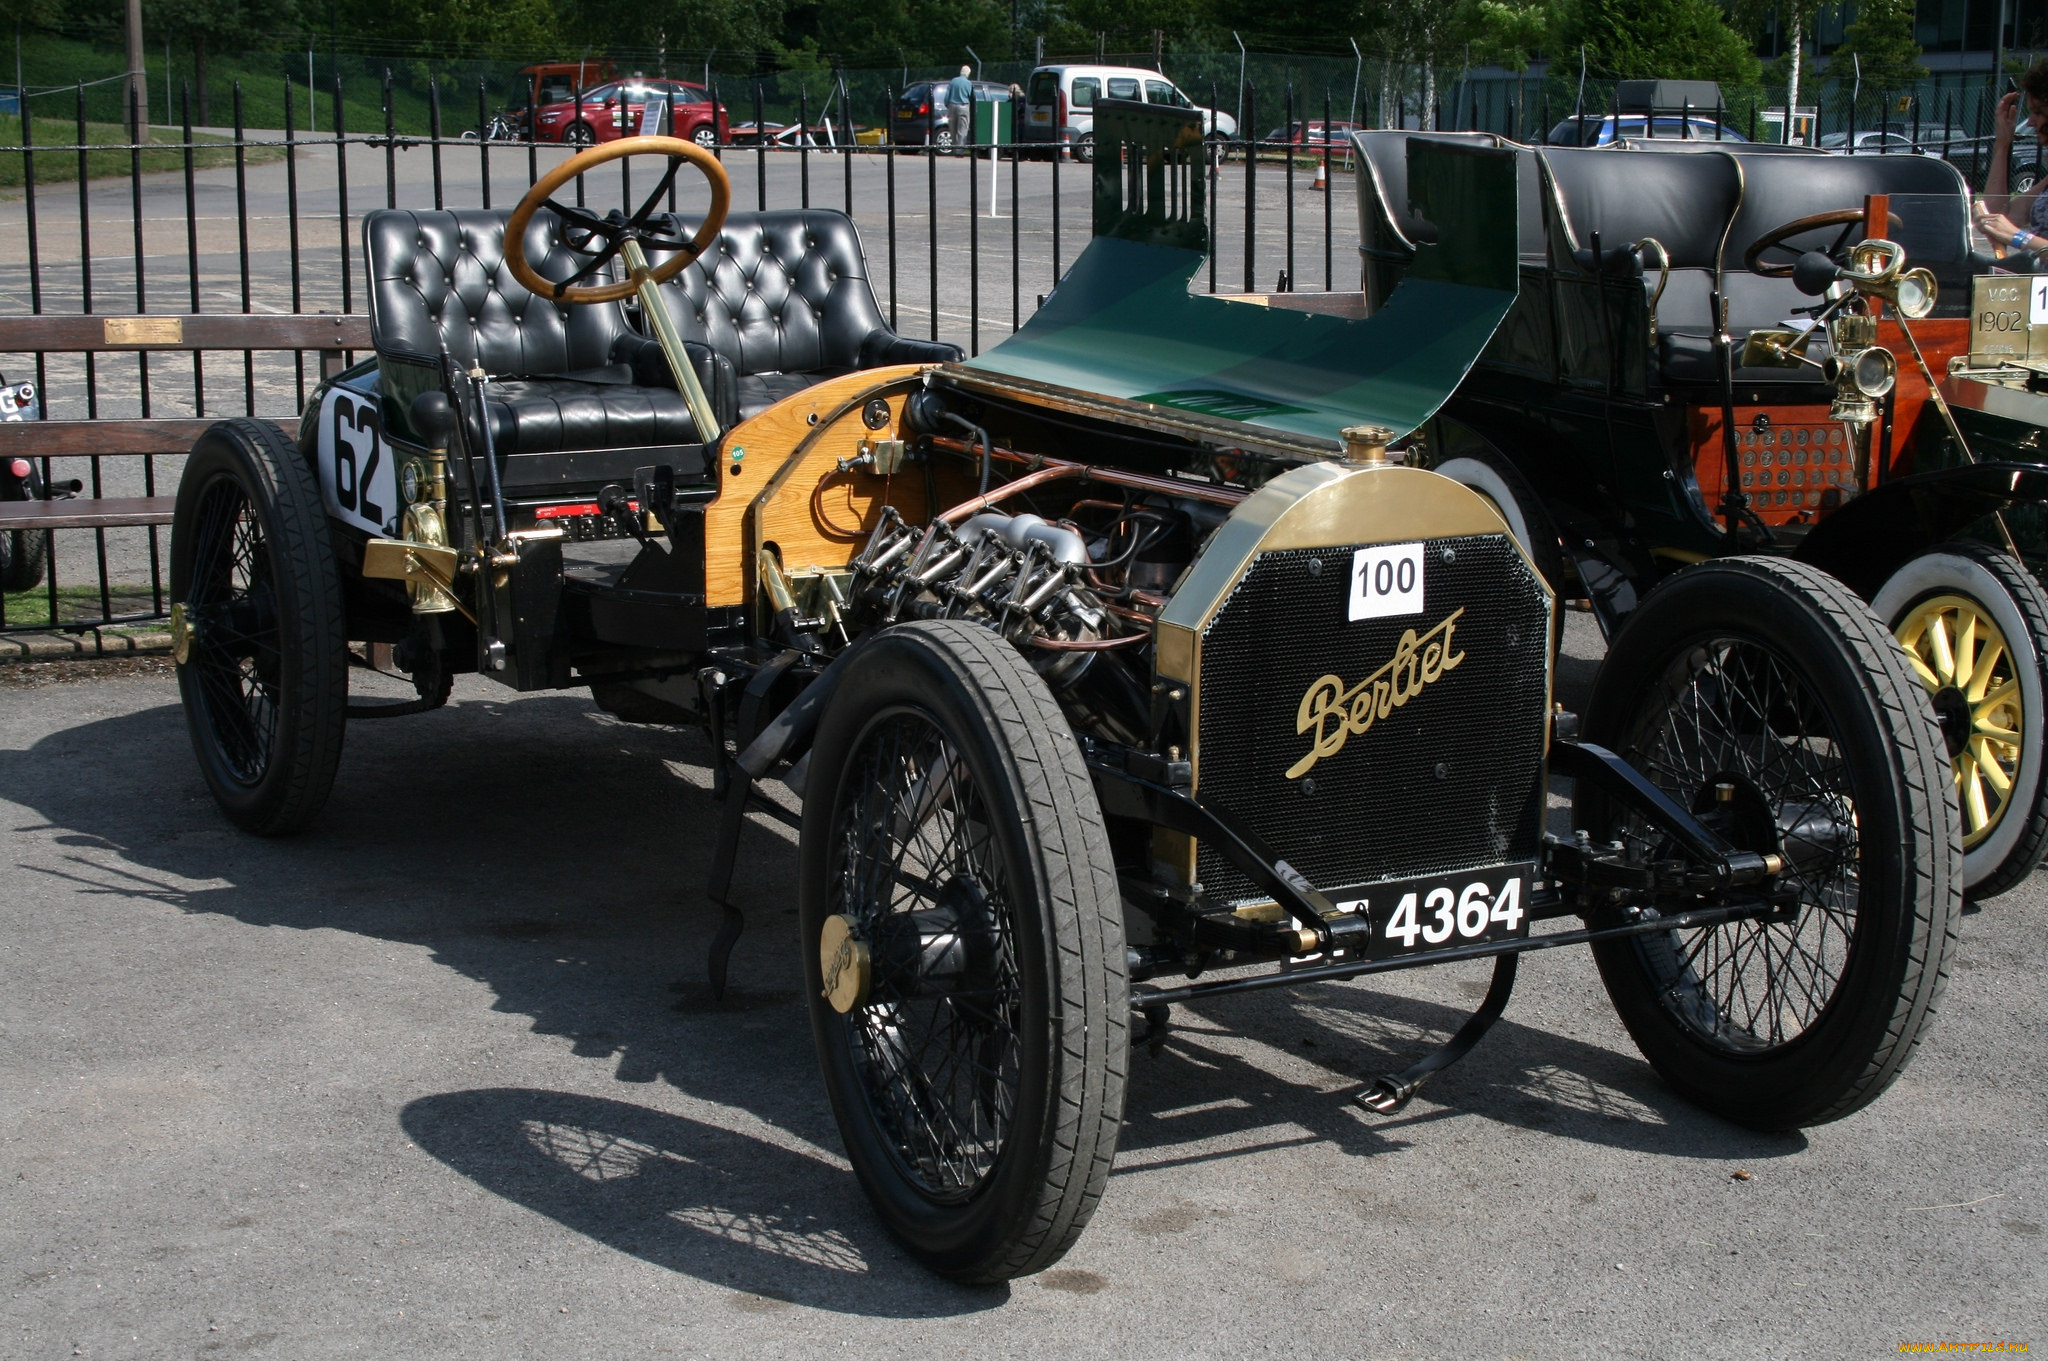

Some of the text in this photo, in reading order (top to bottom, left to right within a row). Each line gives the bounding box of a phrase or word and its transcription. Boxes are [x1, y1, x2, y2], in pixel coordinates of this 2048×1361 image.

[1979, 311, 2022, 332] 1902
[334, 395, 382, 526] 62
[1358, 557, 1415, 597] 100
[1285, 606, 1466, 779] Berliet
[1385, 877, 1523, 947] 4364
